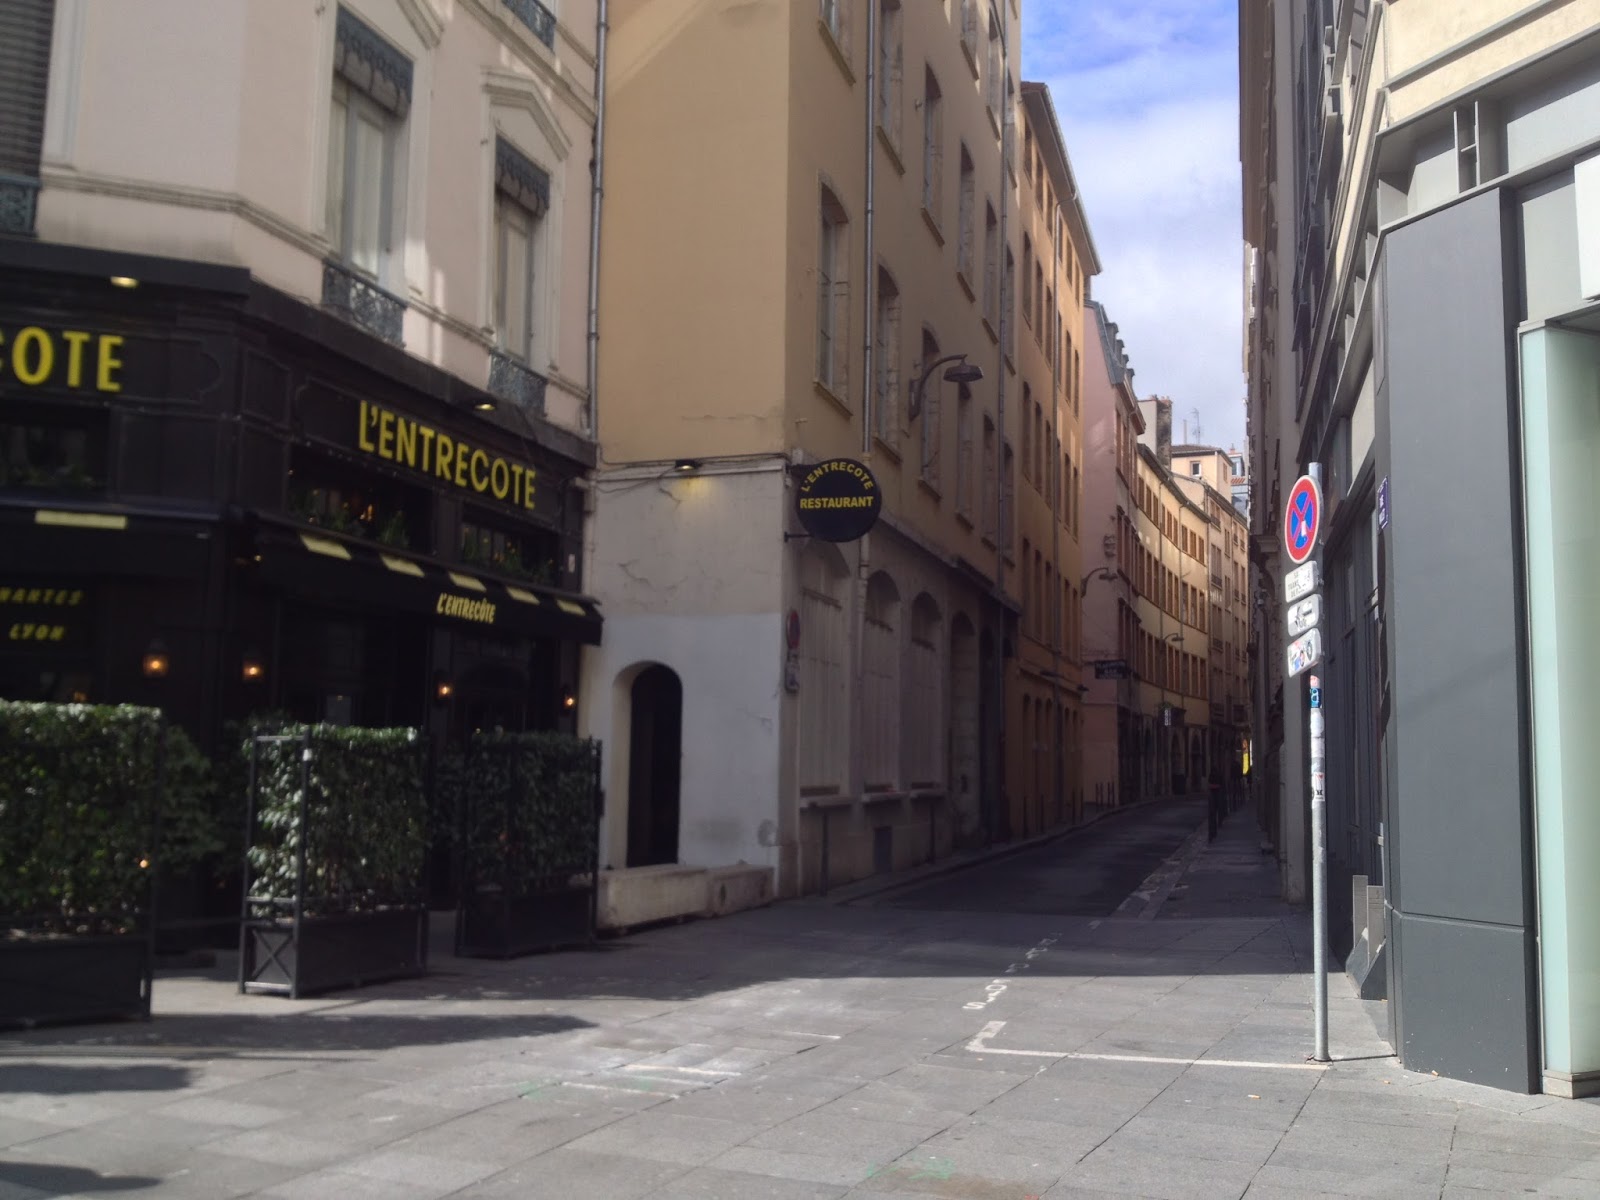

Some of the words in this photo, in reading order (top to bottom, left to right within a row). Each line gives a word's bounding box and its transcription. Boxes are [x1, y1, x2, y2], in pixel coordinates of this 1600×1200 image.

[0, 326, 124, 392] OTE
[358, 399, 537, 511] L'ENTRECOTE
[801, 462, 874, 492] L'ENTRECOTE
[800, 496, 873, 509] RESTAURANT
[8, 623, 65, 641] LYON
